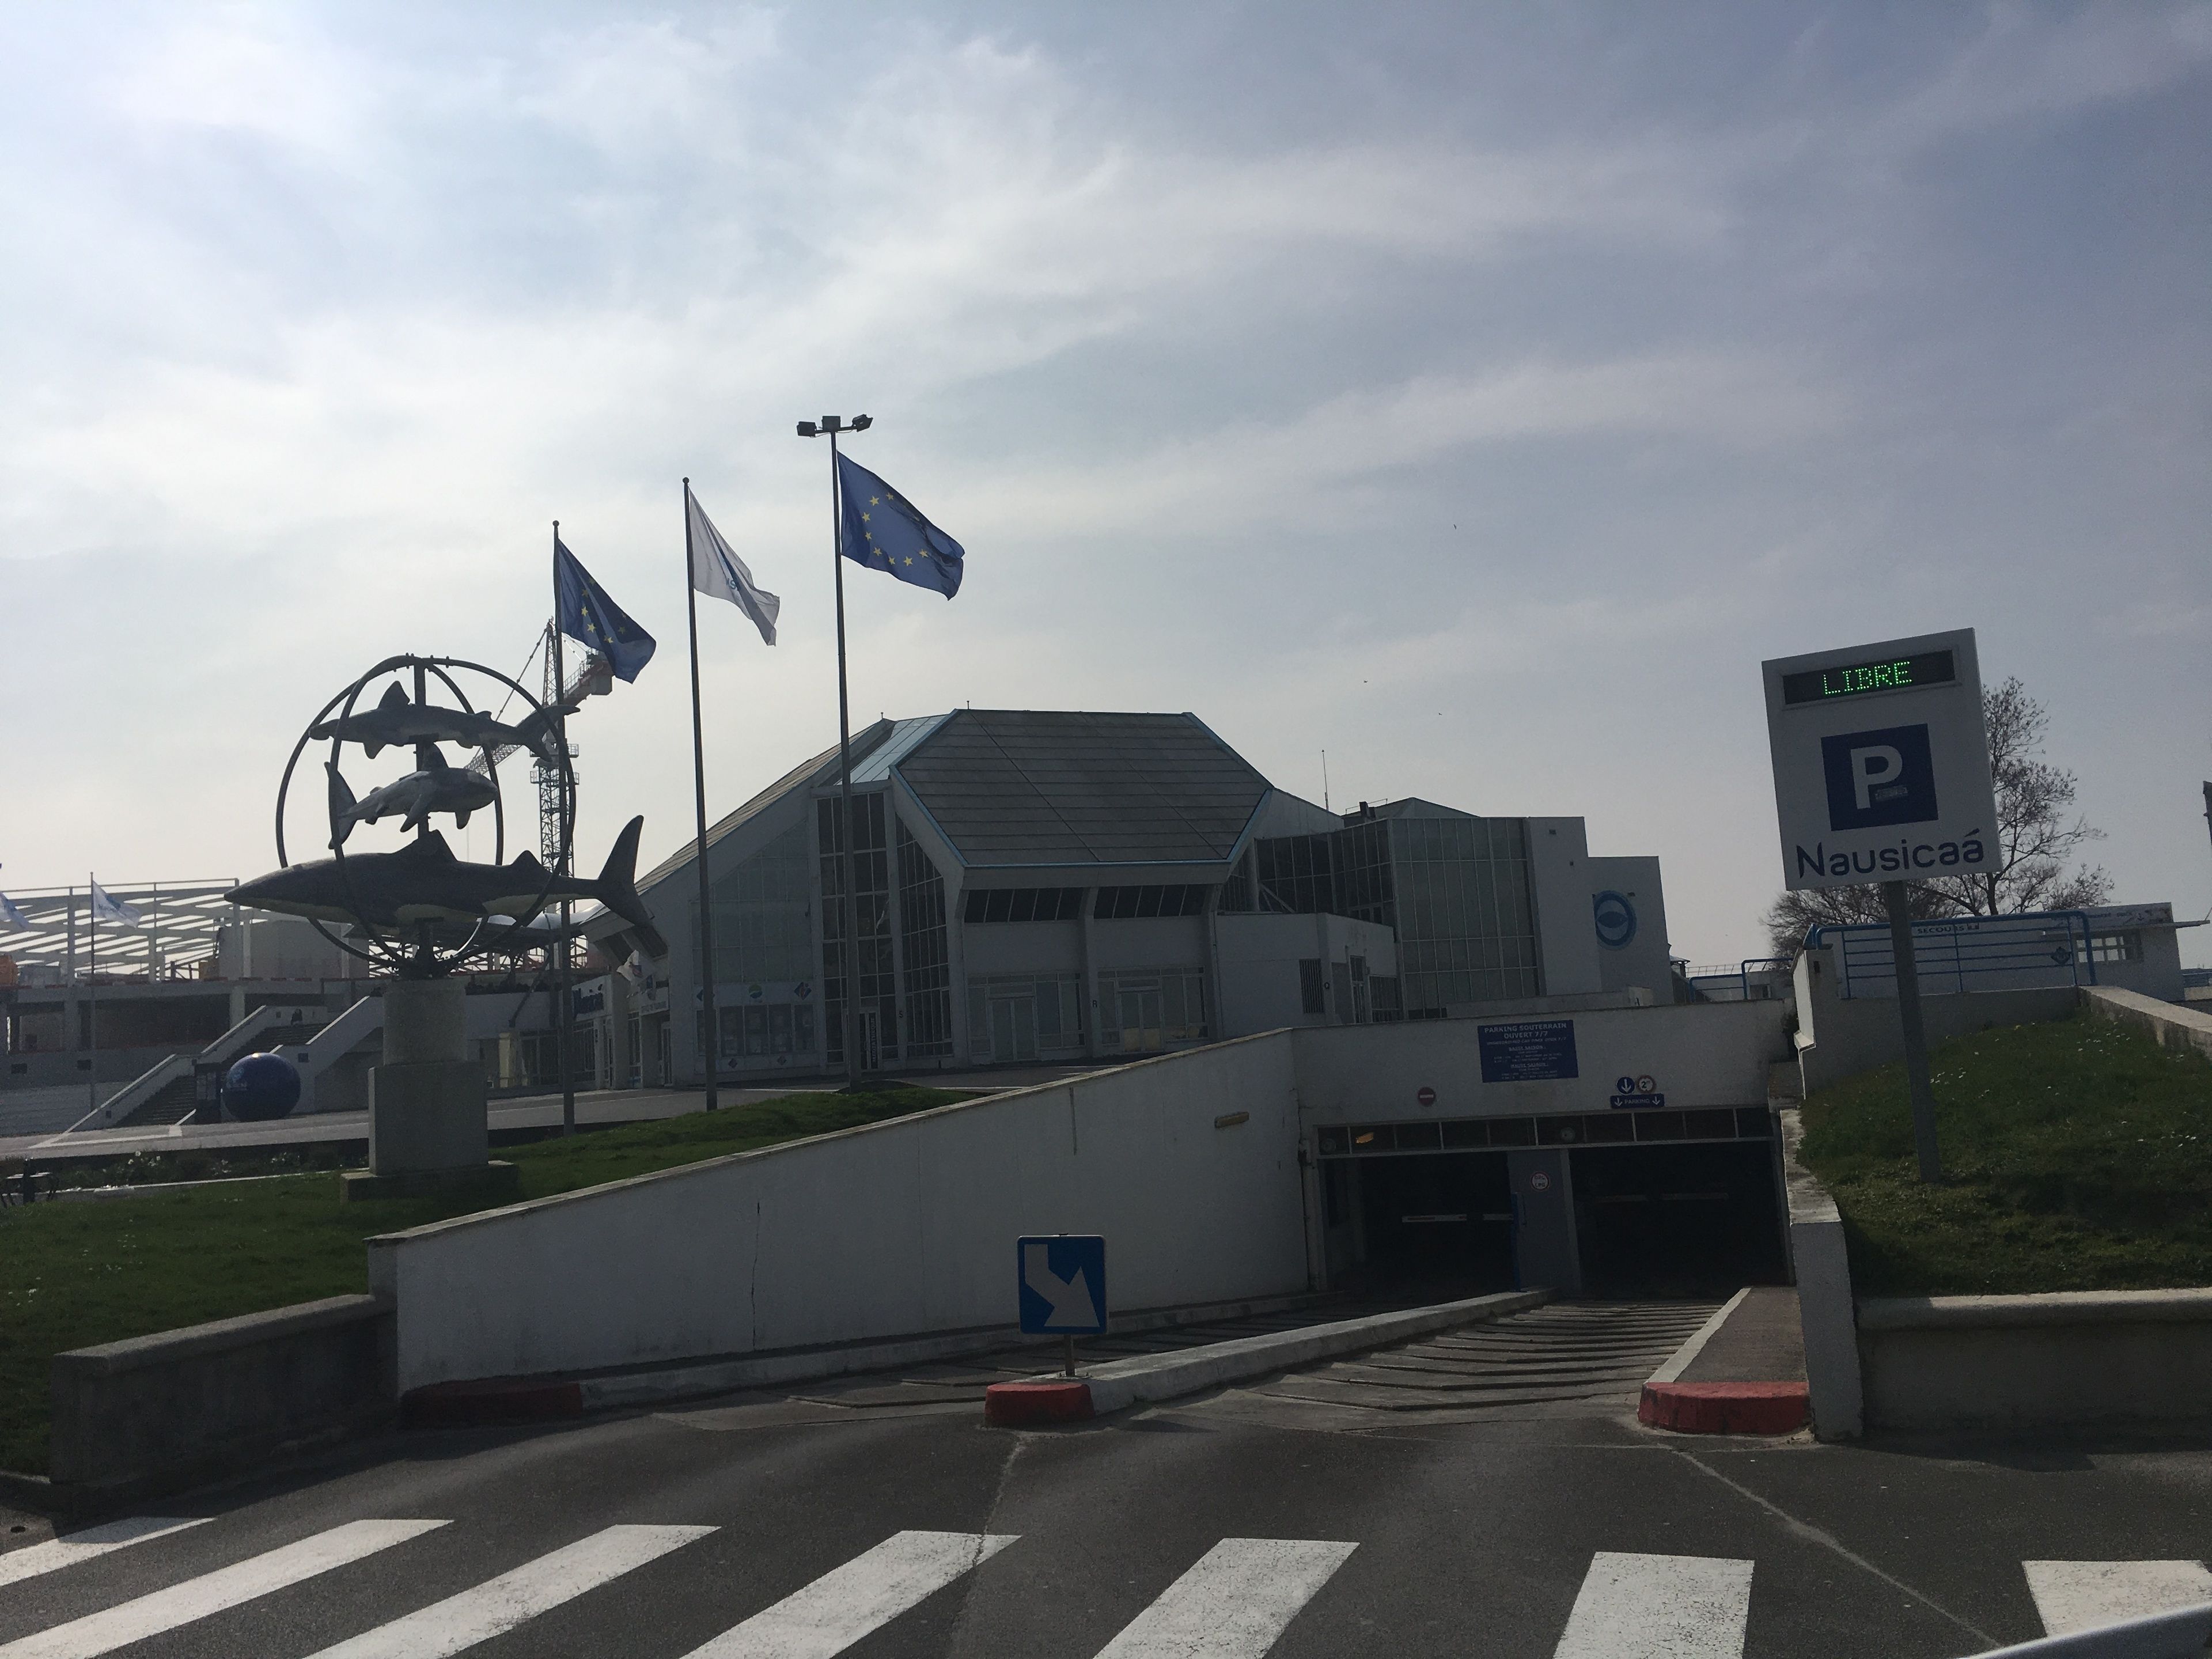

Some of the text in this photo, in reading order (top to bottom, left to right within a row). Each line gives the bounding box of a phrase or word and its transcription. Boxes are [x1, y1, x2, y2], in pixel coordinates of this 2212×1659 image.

[1823, 661, 1912, 695] LIBRE
[1850, 744, 1903, 810] P
[1796, 827, 1985, 879] Nausicaá
[1503, 1031, 1533, 1039] OUVERT
[1518, 1022, 1567, 1031] SOUTERRAIN
